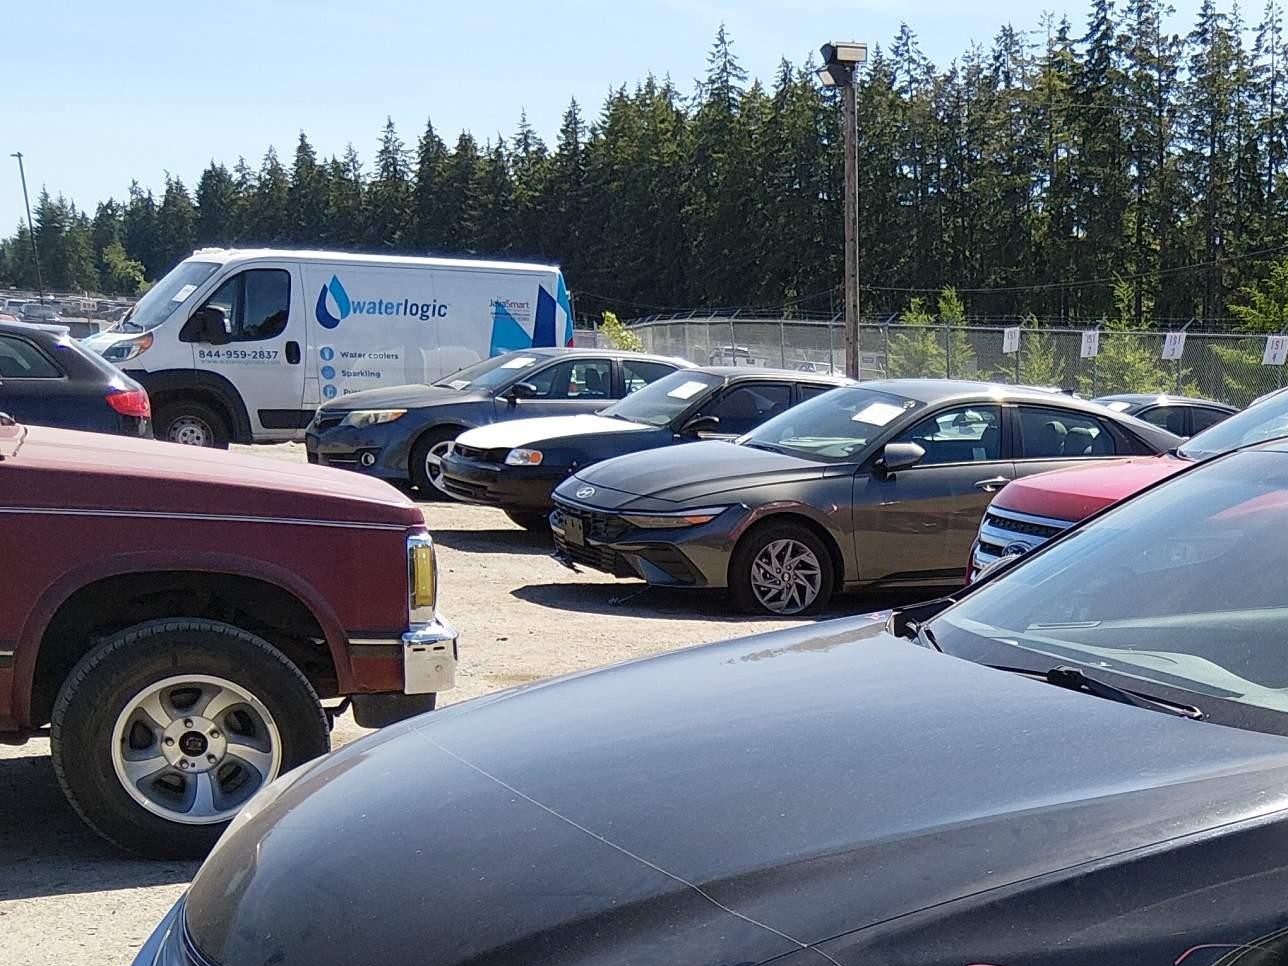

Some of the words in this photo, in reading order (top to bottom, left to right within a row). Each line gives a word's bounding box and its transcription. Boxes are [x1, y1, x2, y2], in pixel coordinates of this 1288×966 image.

[351, 299, 448, 321] waterlogic
[198, 350, 279, 360] 844-959-2837
[340, 351, 367, 360] Water
[368, 352, 400, 360] coolers
[341, 370, 381, 379] Sparkling
